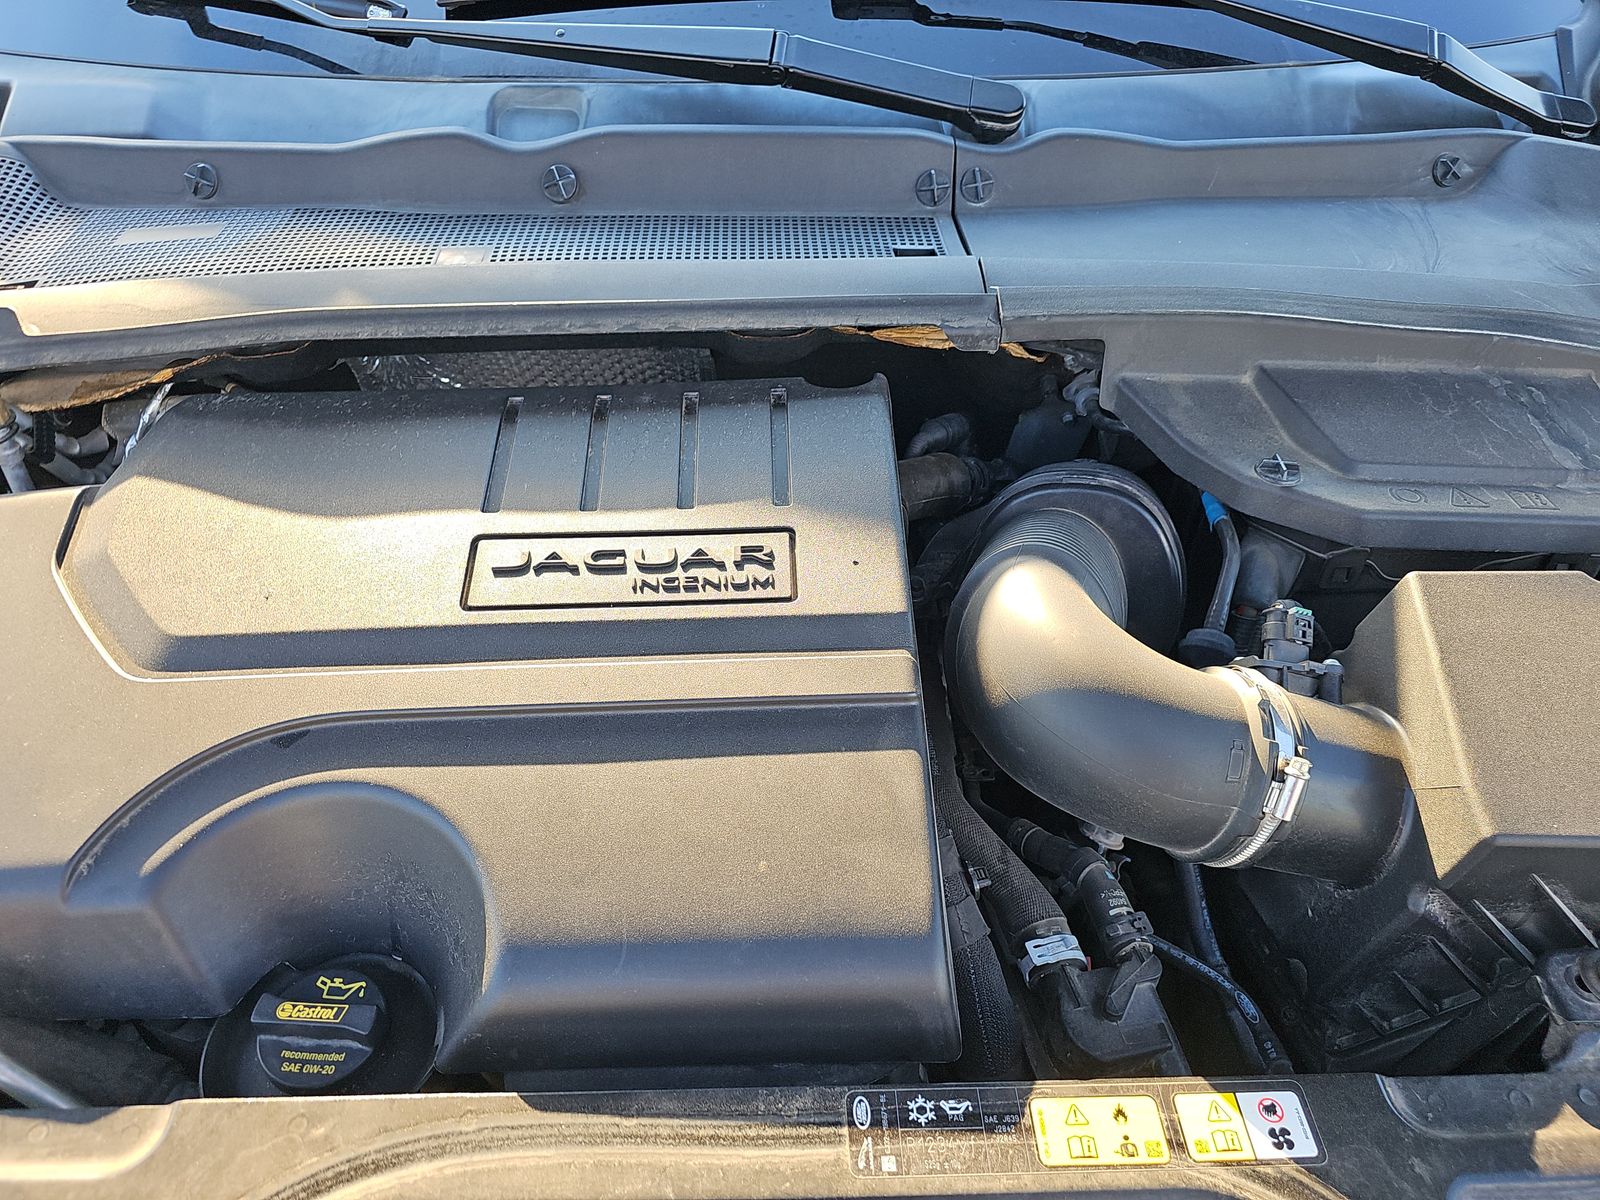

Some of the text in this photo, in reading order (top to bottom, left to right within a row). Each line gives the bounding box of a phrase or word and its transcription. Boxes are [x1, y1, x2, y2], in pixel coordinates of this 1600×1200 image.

[491, 545, 776, 578] JAGUAR
[631, 575, 776, 595] INGENIUM
[291, 1004, 339, 1020] Castrol
[280, 1050, 346, 1062] recommended
[281, 1062, 336, 1075] SAE 0W-20
[948, 1114, 965, 1122] PAG
[984, 1115, 999, 1123] SAE
